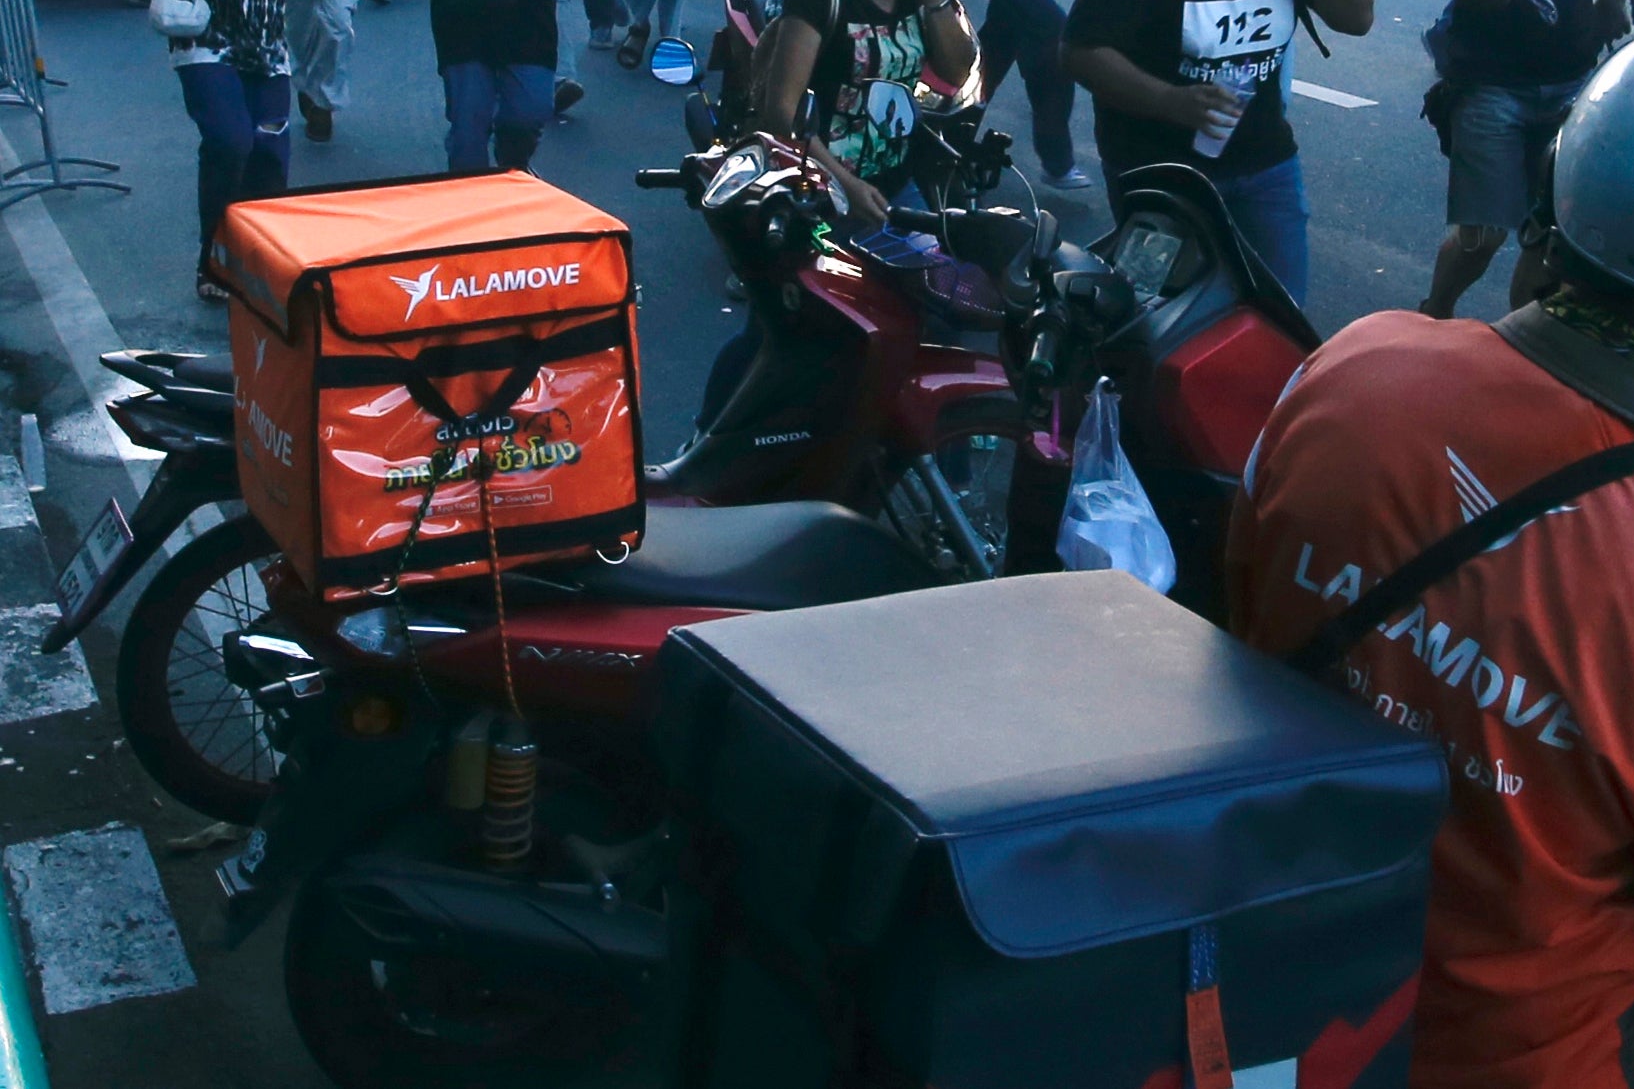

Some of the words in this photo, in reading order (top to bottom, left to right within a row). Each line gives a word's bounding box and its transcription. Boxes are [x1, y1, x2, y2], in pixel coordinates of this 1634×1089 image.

[1216, 7, 1273, 45] 112
[435, 263, 580, 301] LALAMOVE
[754, 431, 811, 446] HONDA
[1294, 542, 1582, 750] LAAMOVE
